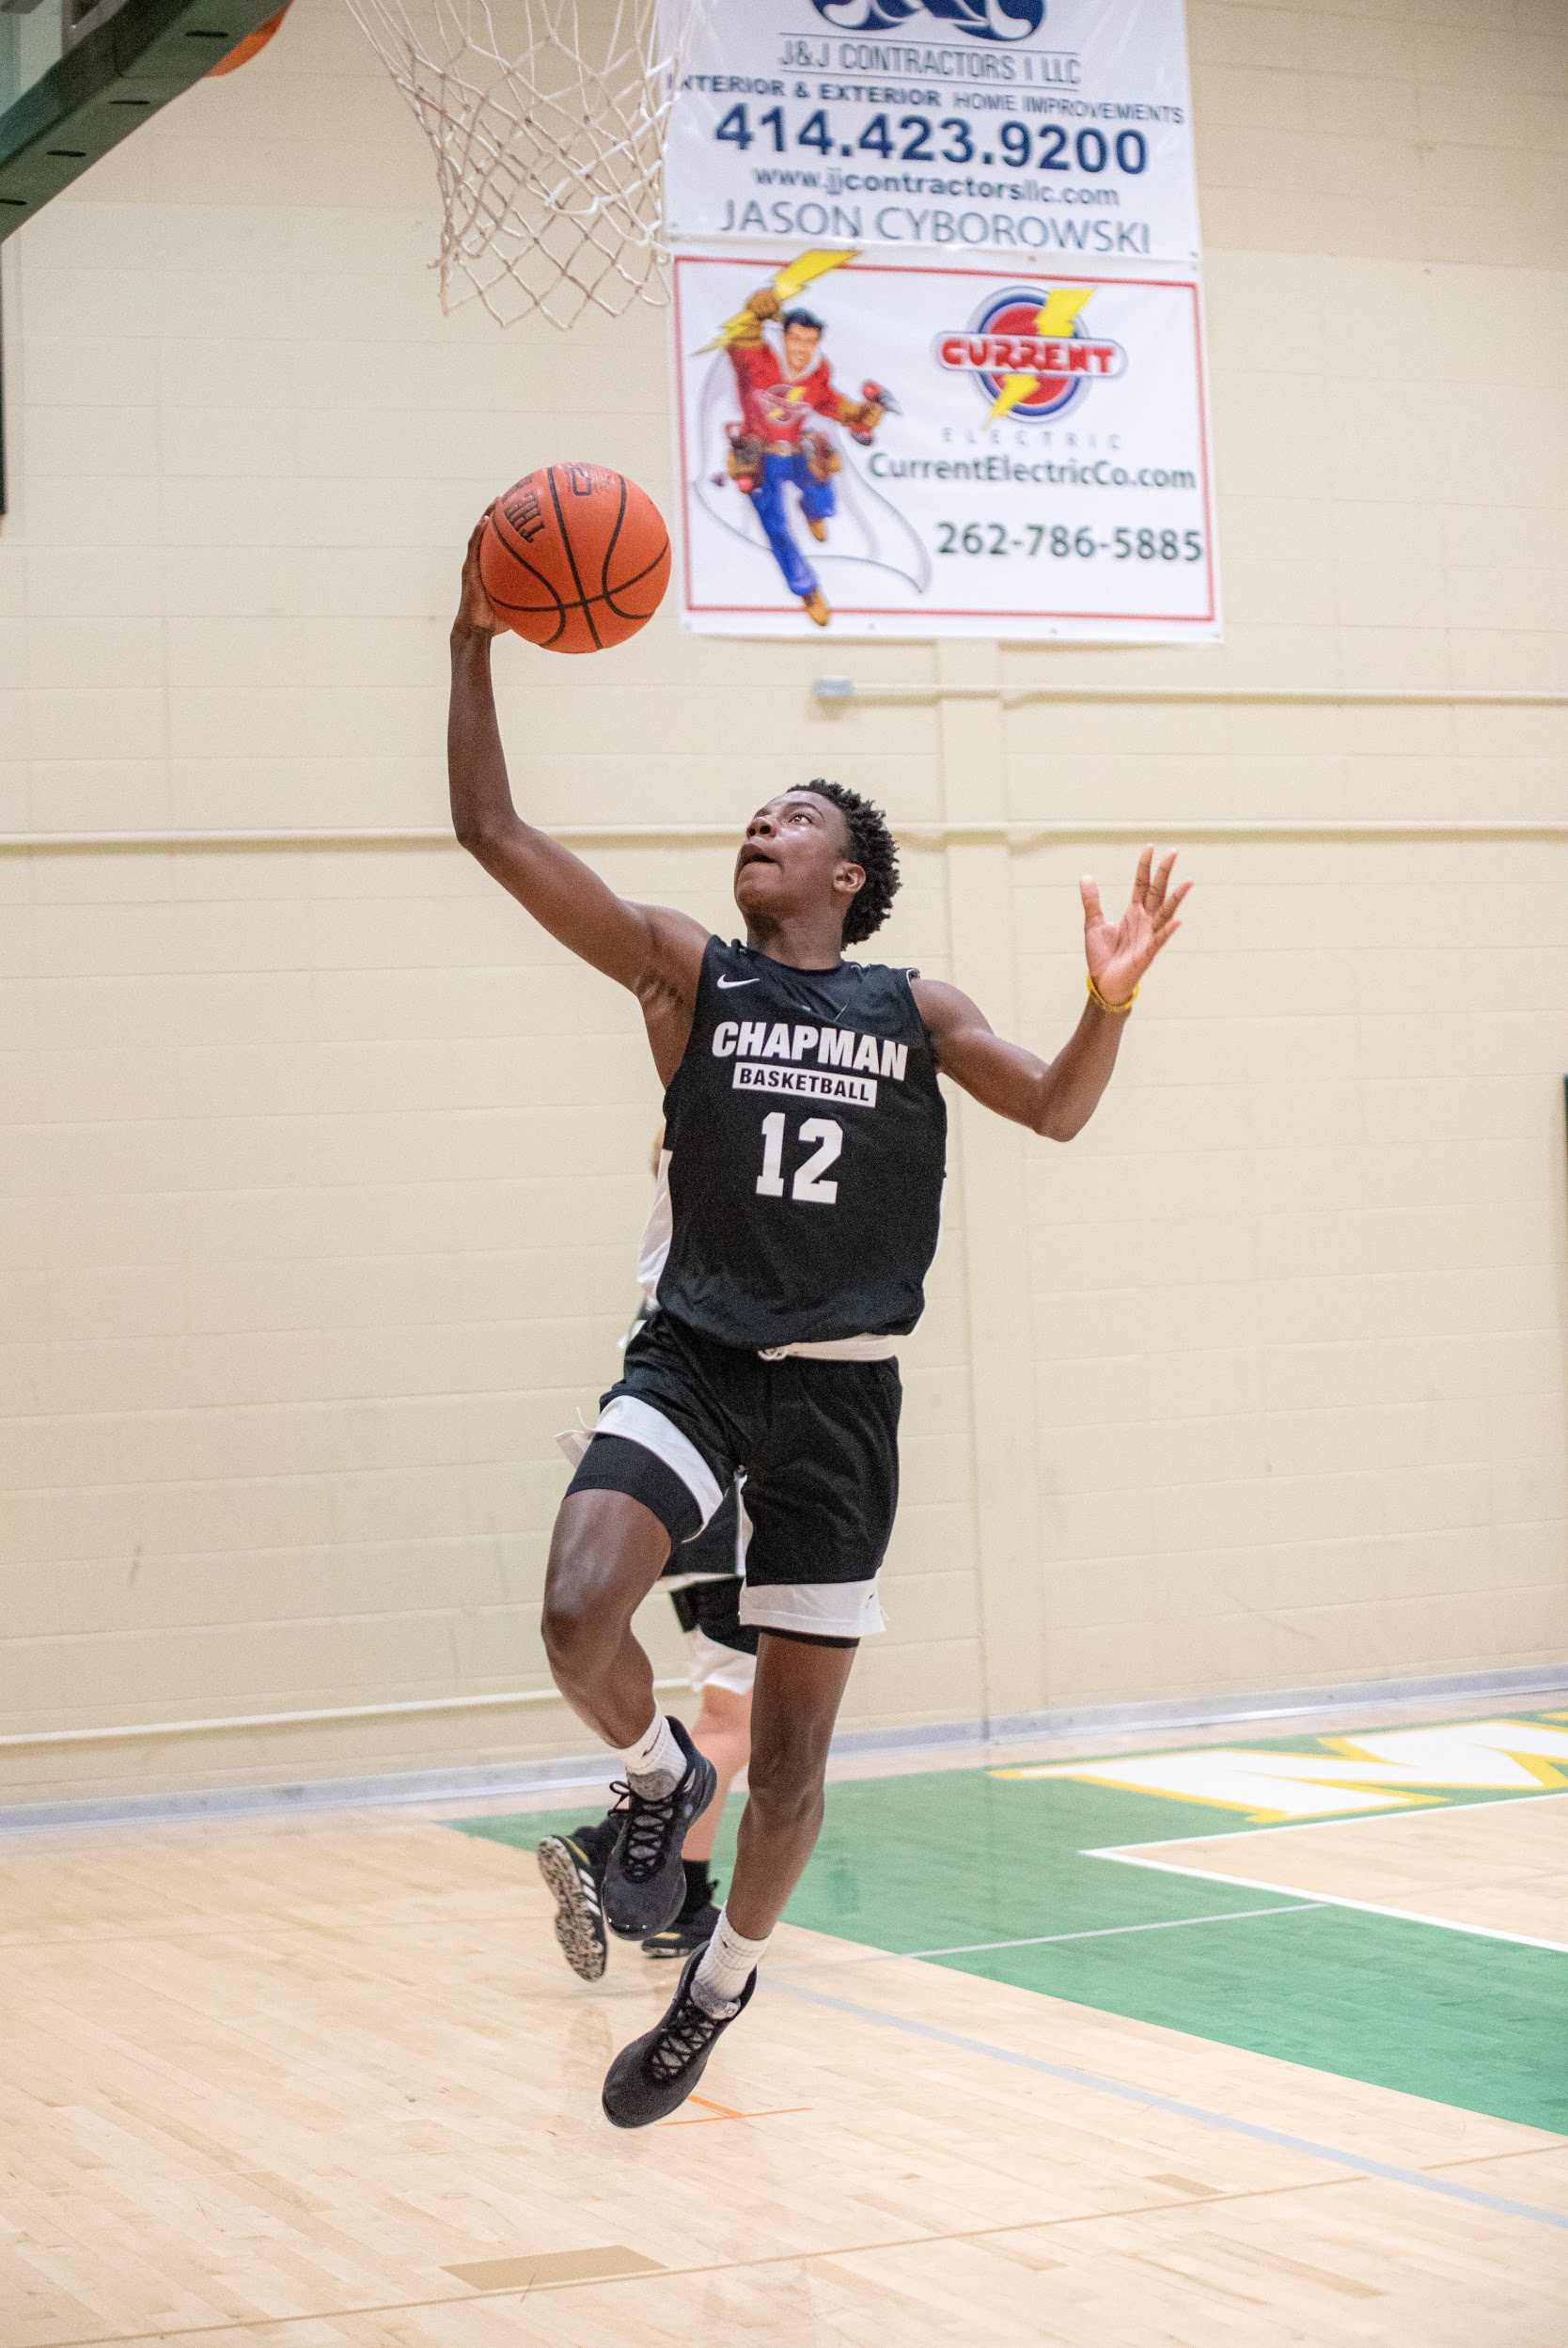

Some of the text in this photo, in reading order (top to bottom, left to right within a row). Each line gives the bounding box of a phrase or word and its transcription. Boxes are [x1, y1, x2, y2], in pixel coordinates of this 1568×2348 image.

[838, 42, 1016, 80] CONTRACTORS
[1041, 57, 1081, 85] LLC
[794, 81, 809, 99] &
[819, 83, 940, 107] EXTERIOR
[952, 91, 1017, 112] HOME
[1023, 96, 1184, 124] IMPROVEMENTS
[714, 102, 1149, 175] 414.423.9200
[753, 166, 1120, 206] www.jjcontractorsllc.com
[720, 198, 1151, 255] JASON CYBOROWSKI
[941, 338, 1115, 375] CURRENT
[942, 427, 1121, 449] ELECTRIC
[867, 451, 1197, 491] CurrentElectricCo.com
[937, 522, 1203, 562] 262-786-5885
[712, 1021, 909, 1082] CHAPMAN
[739, 1067, 870, 1102] BASKETBALL
[756, 1111, 844, 1204] 12
